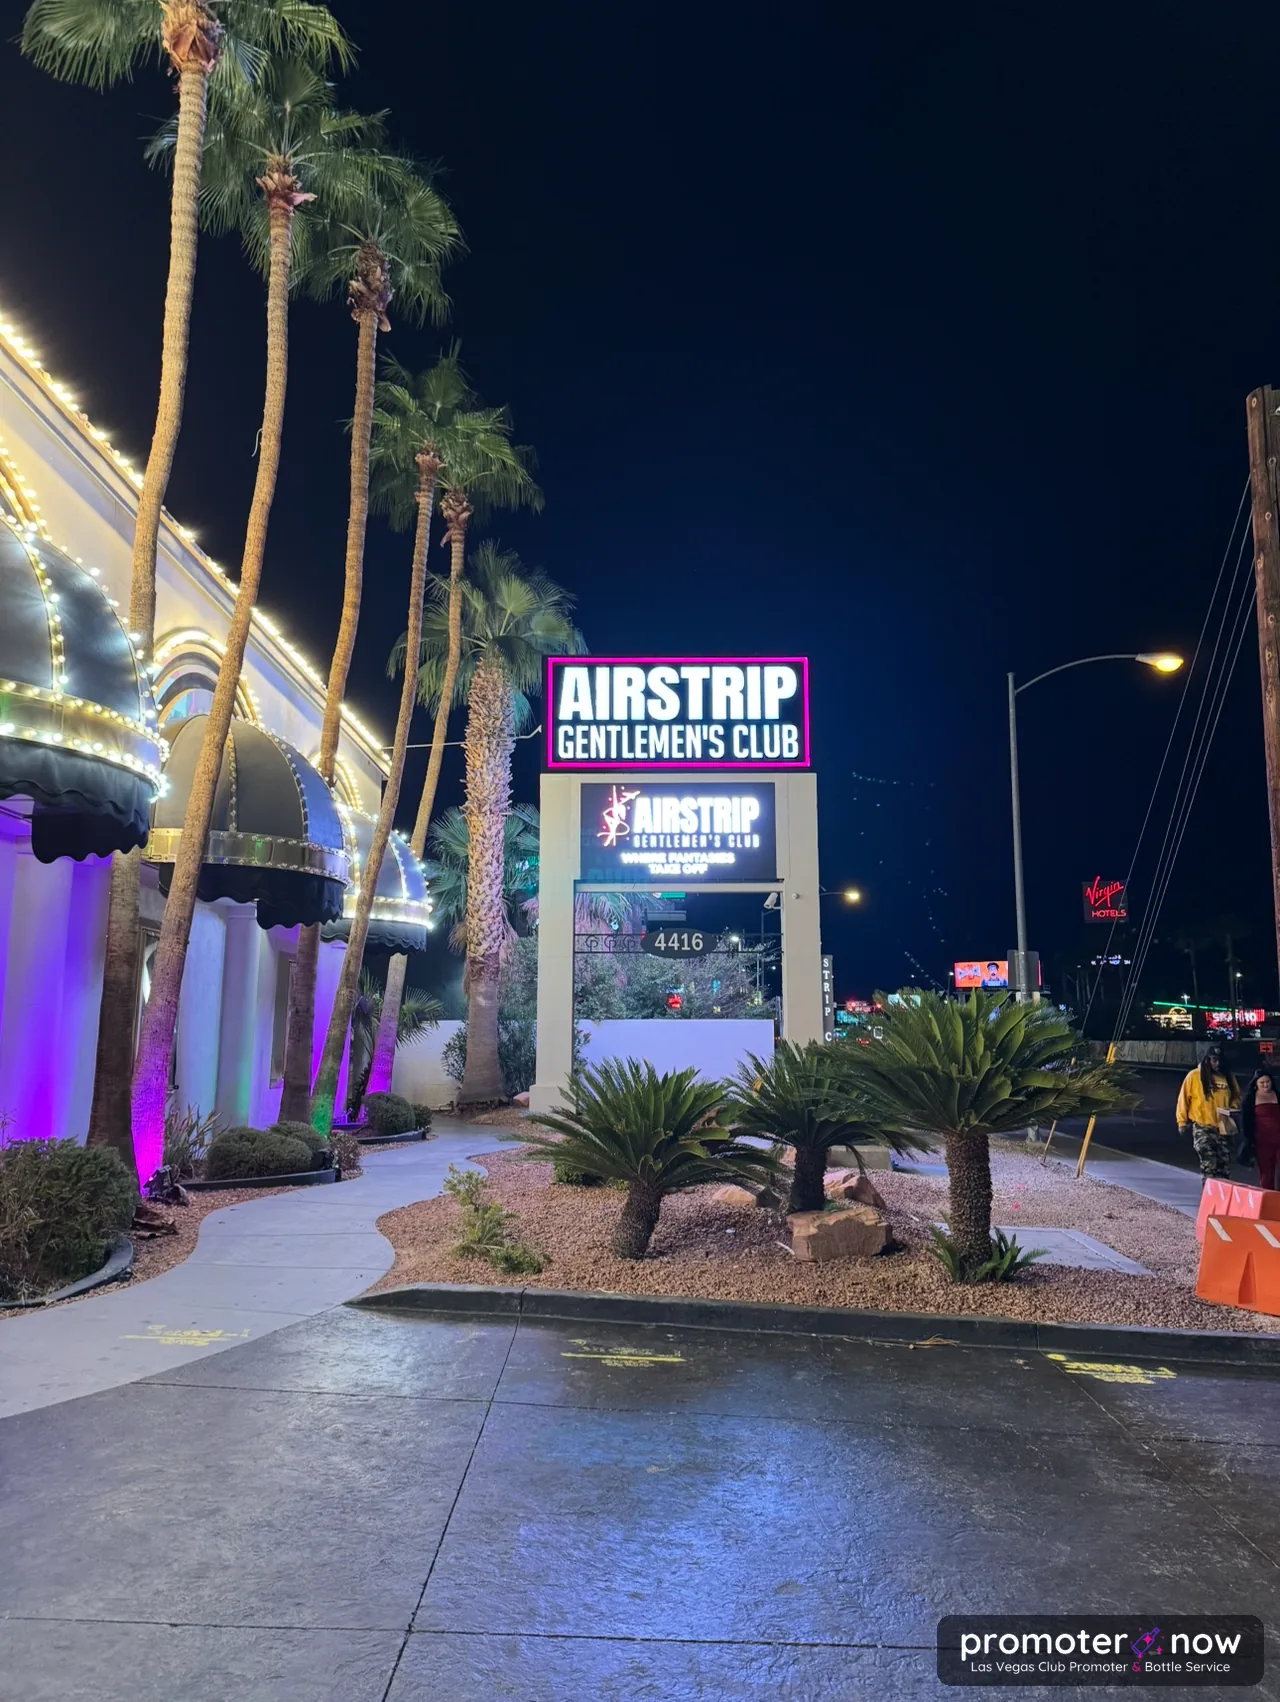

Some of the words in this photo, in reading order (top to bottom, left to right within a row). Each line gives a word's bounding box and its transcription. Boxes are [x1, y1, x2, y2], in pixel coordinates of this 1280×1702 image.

[558, 665, 798, 721] AIRSTRIP
[558, 724, 725, 759] GENTLEMEN'S
[733, 724, 799, 759] CLUB
[633, 796, 760, 834] AIRSTRIP
[633, 835, 721, 848] GENTLEMEN'S
[728, 834, 760, 848] CLUB
[620, 852, 666, 864] WHERE
[648, 864, 681, 875] TAKE
[682, 864, 708, 875] OFF
[1085, 875, 1124, 907] Virgin
[1091, 909, 1127, 918] HOTELS
[654, 932, 704, 951] 4416
[823, 958, 831, 1016] STRIP
